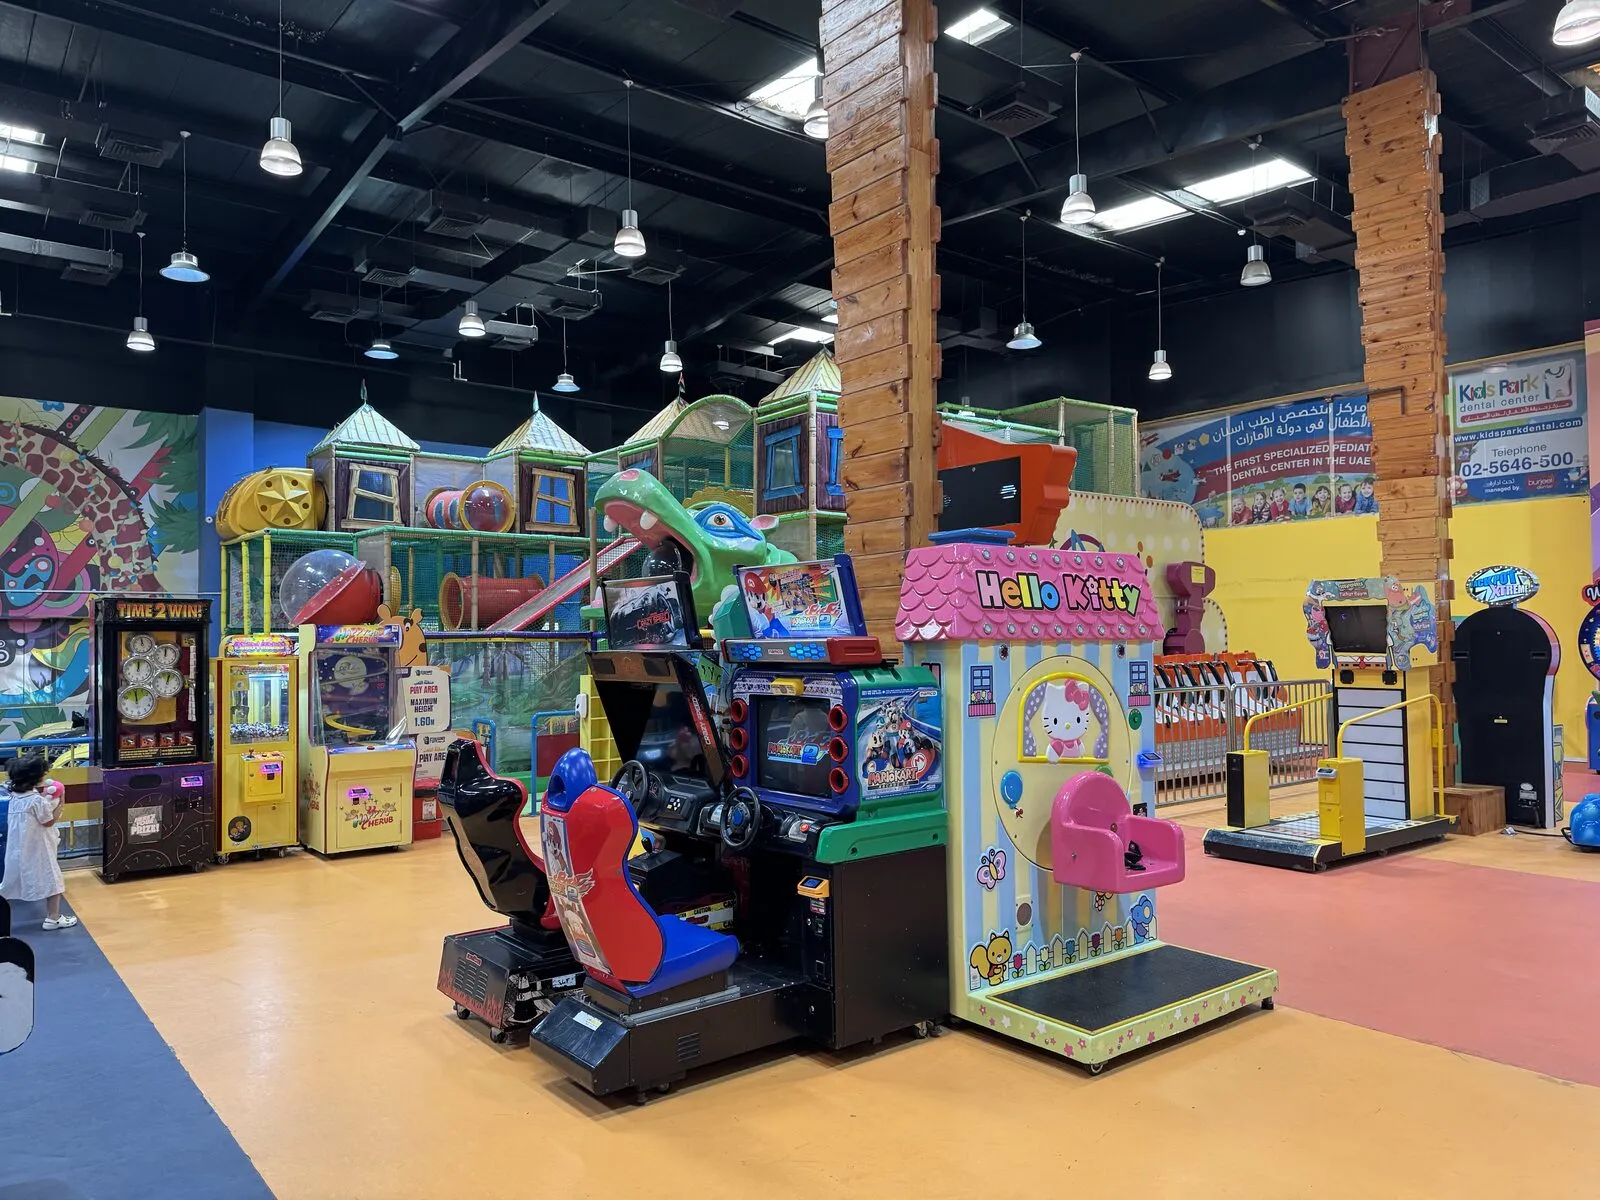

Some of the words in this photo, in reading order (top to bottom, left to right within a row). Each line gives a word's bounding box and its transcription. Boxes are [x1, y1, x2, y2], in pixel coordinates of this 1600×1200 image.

[1459, 380, 1496, 403] Kids
[1499, 373, 1540, 397] Park
[1336, 402, 1367, 417] مركز
[1460, 399, 1496, 413] dental
[1500, 393, 1540, 407] center
[1248, 412, 1275, 431] لطب
[1329, 415, 1371, 432] لأطفال
[1454, 418, 1582, 442] www.kidsparkdental.com
[1276, 424, 1302, 437] دولة
[1492, 443, 1548, 458] Telephone
[1214, 463, 1233, 477] THE
[1234, 455, 1262, 472] FIRST
[1264, 444, 1330, 461] SPECIALIZED
[1232, 467, 1269, 482] DENTAL
[1270, 458, 1310, 472] CENTER
[1312, 457, 1324, 466] IN
[1325, 456, 1346, 466] THE
[1348, 456, 1372, 466] UAE
[1462, 452, 1574, 477] 02-5646-500
[1484, 485, 1512, 494] managed
[1512, 485, 1520, 493] by
[976, 570, 1061, 611] Hello
[1063, 573, 1142, 618] Kitty
[117, 603, 153, 618] TIME
[154, 602, 167, 619] 2
[168, 603, 203, 618] WIN!
[818, 613, 832, 628] 2
[409, 686, 422, 695] PLAY
[424, 684, 438, 694] AREA
[410, 697, 438, 706] MAXIMUM
[414, 705, 434, 713] HEIGHT
[801, 742, 821, 765] 2
[361, 816, 394, 831] CHERUB
